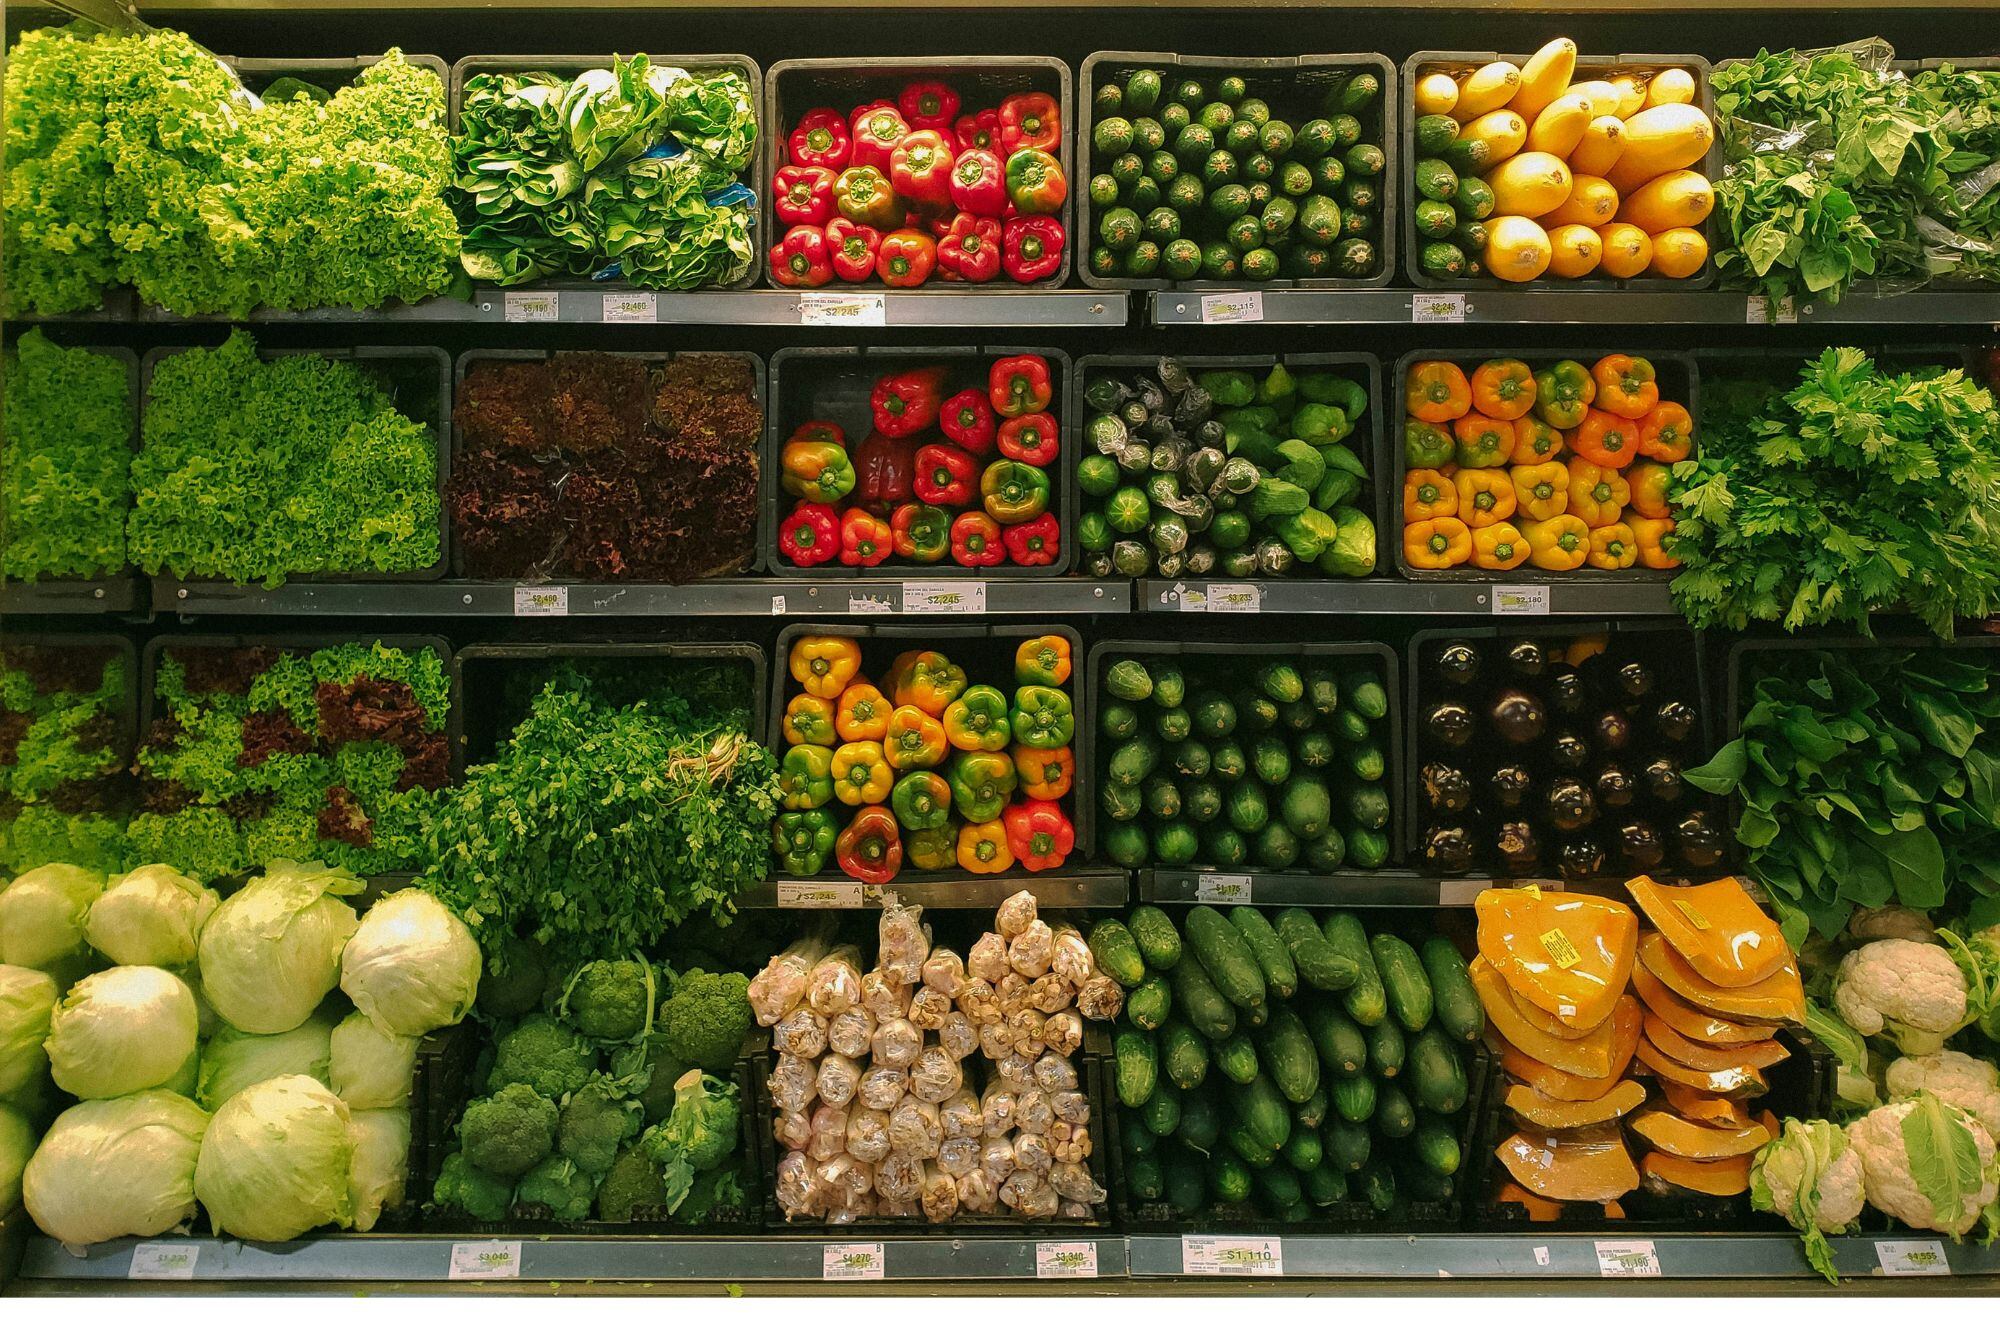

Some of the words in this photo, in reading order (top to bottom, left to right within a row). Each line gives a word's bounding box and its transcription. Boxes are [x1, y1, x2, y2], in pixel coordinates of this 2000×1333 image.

[875, 299, 883, 308] A
[975, 587, 983, 596] A
[927, 595, 960, 606] $2,245
[1263, 1242, 1270, 1250] A
[1227, 1251, 1272, 1261] $1,110
